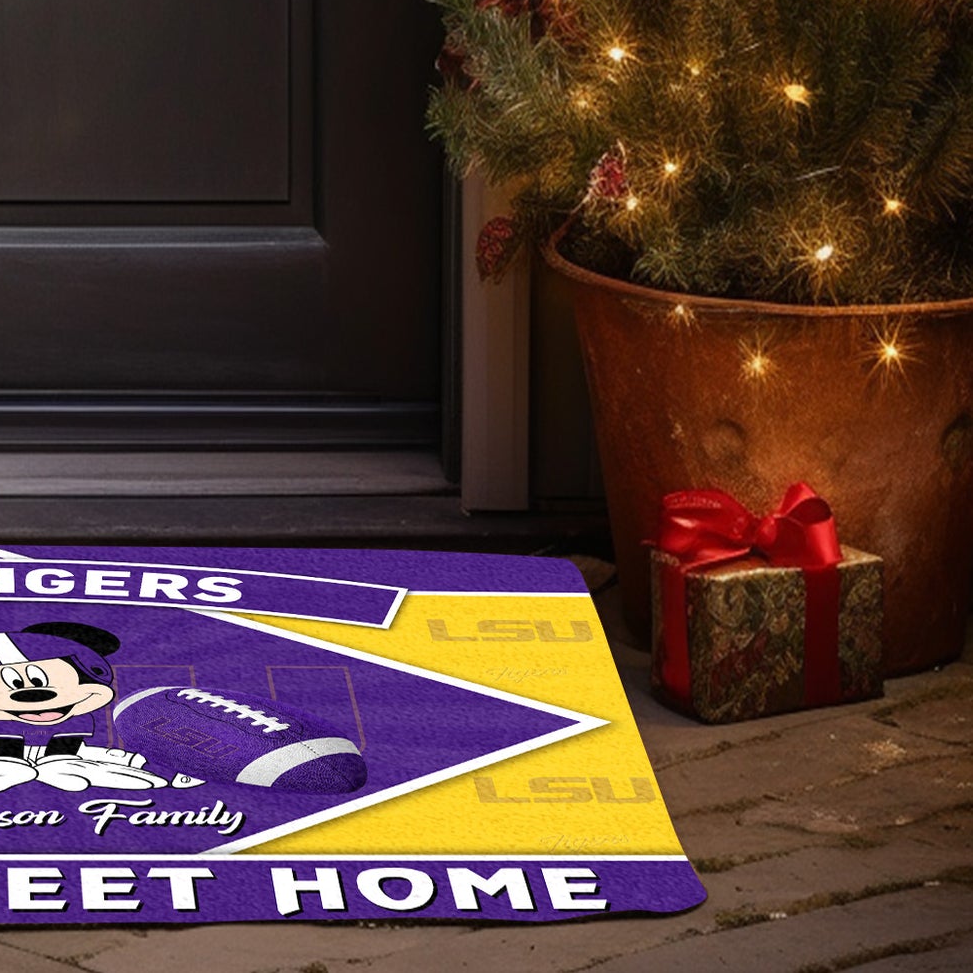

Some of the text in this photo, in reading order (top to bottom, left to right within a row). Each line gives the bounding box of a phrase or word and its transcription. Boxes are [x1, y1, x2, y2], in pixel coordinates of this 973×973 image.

[427, 619, 594, 643] LSU
[473, 776, 657, 804] LSU
[78, 798, 245, 836] Family
[270, 866, 610, 918] HOME
